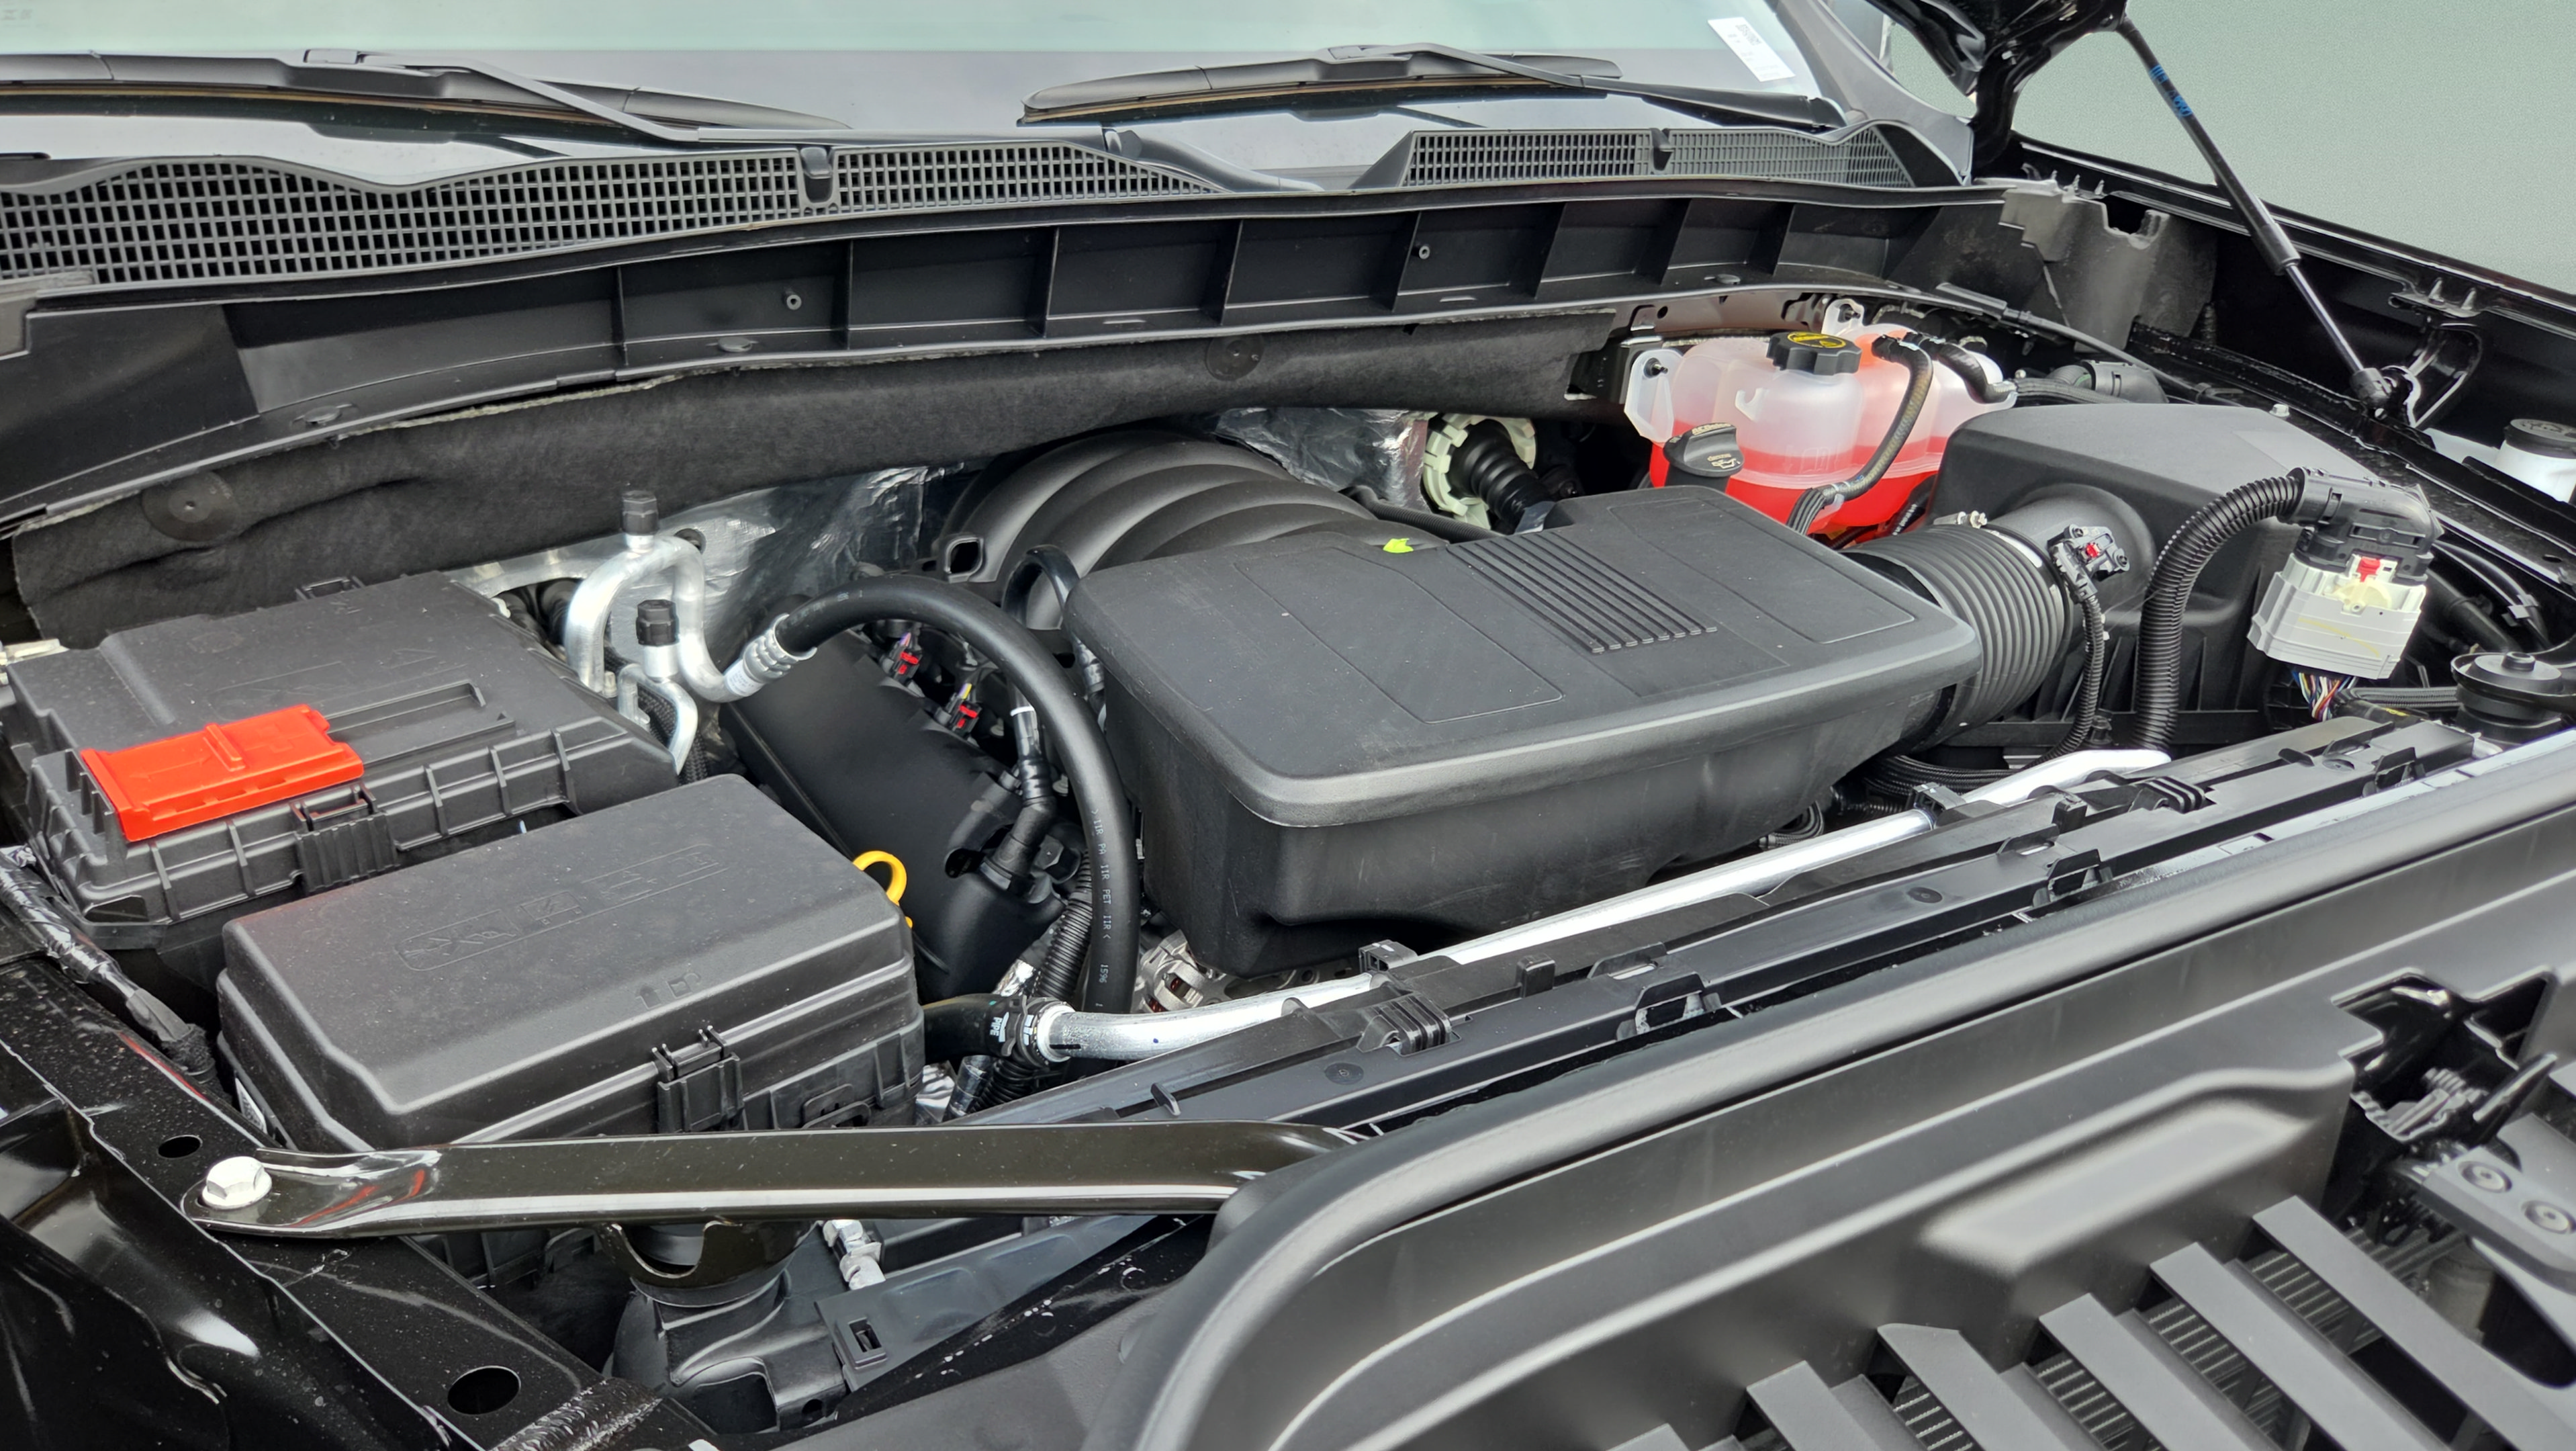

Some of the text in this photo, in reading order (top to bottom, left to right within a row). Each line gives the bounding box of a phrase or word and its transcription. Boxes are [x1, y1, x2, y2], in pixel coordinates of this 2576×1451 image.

[1098, 843, 1107, 855] PA
[1100, 864, 1111, 881] IIR
[1102, 888, 1112, 905] PET
[989, 1016, 1003, 1037] PIPE
